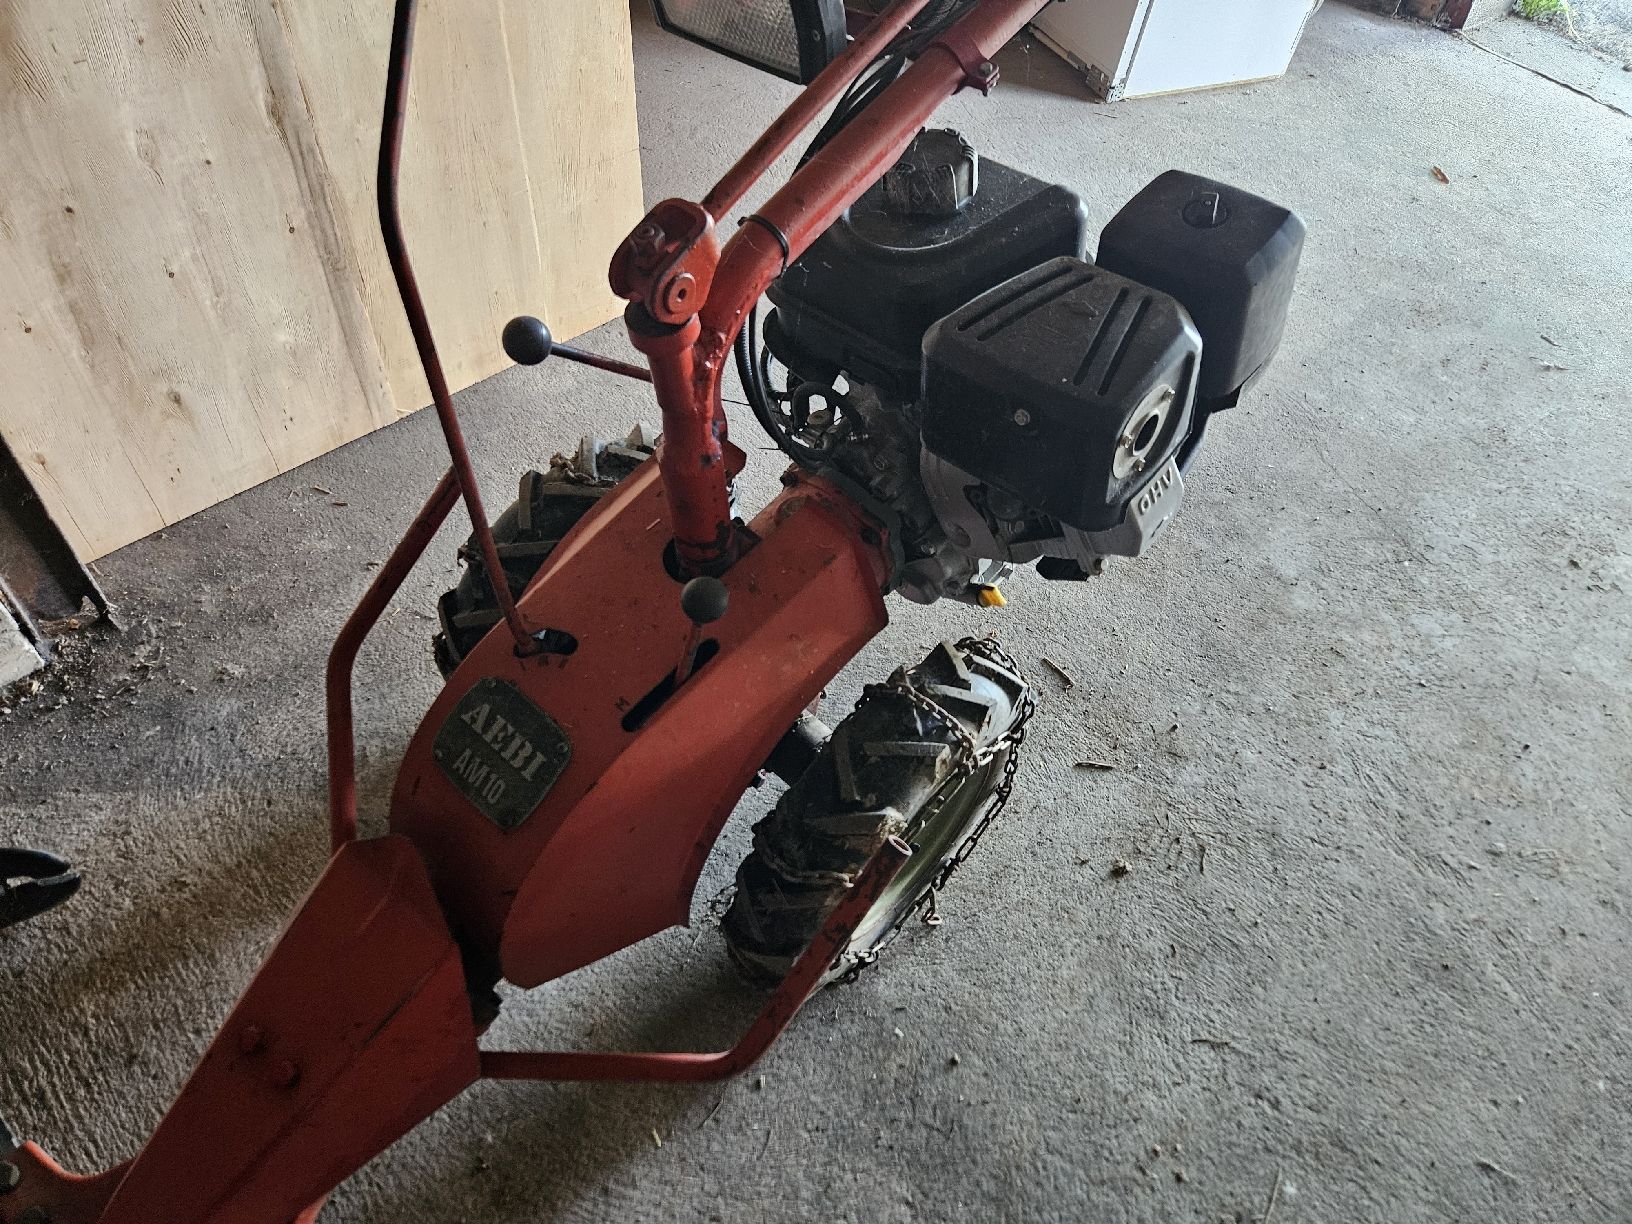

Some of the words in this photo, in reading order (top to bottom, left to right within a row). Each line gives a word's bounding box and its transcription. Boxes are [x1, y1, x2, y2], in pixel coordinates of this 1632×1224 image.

[1138, 467, 1173, 516] OHV
[460, 702, 547, 782] AEBI
[452, 748, 507, 804] AM10
